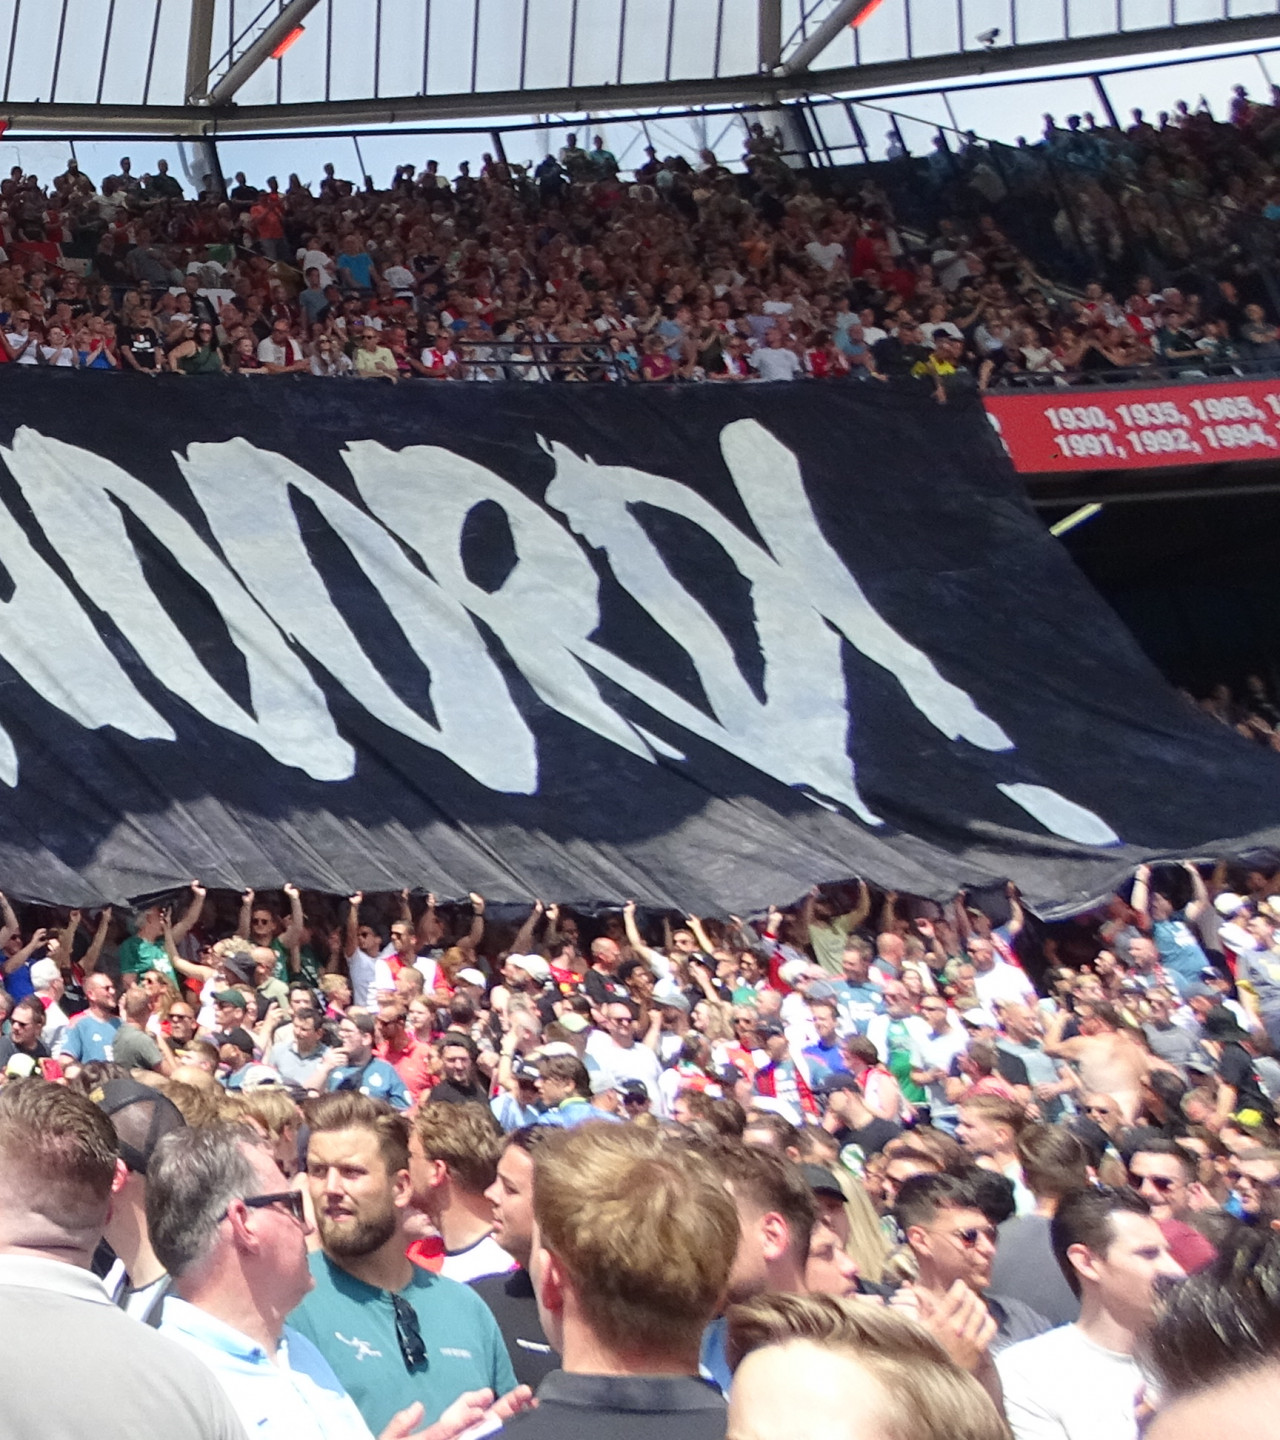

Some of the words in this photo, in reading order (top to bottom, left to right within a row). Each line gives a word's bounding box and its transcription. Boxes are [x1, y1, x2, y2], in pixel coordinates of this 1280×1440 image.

[1044, 406, 1118, 433] 1930,
[1115, 401, 1192, 428] 1935,
[1189, 396, 1268, 422] 1965,
[1054, 433, 1128, 459] 1991,
[1126, 427, 1203, 455] 1992,
[1200, 422, 1279, 449] 1994,
